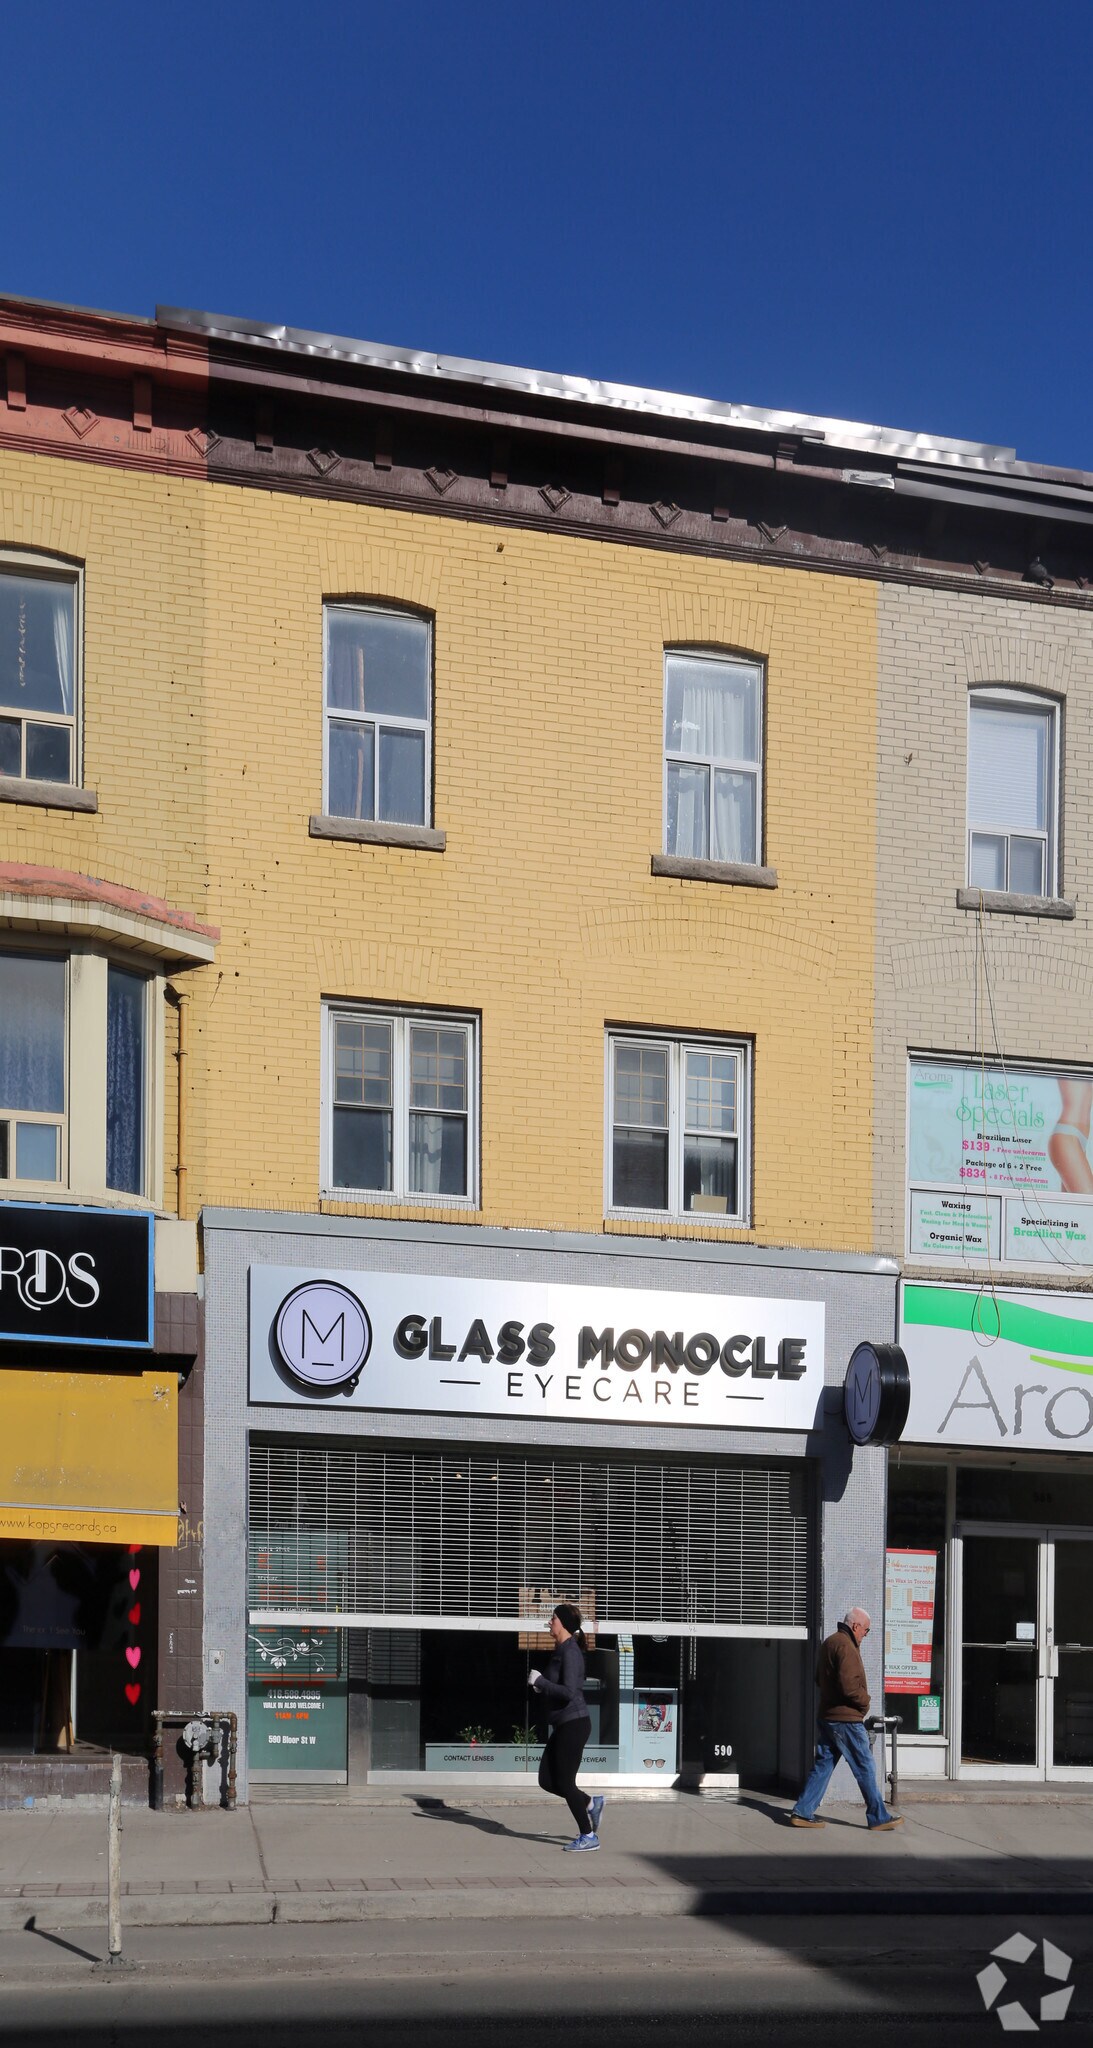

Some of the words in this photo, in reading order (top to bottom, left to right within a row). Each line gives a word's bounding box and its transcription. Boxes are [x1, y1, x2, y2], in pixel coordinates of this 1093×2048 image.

[915, 1069, 953, 1082] Aroma
[974, 1072, 1029, 1102] Laser
[956, 1097, 1045, 1131] Specials
[977, 1133, 1010, 1142] Brazilian
[1012, 1136, 1032, 1144] Laser
[962, 1140, 990, 1151] $139
[966, 1159, 996, 1169] Package
[959, 1167, 986, 1179] $834
[941, 1201, 971, 1211] Waxing
[1021, 1217, 1068, 1228] Specializing
[929, 1232, 963, 1242] Organic
[965, 1235, 982, 1243] Wax
[1013, 1226, 1062, 1239] Brazilian
[1065, 1230, 1086, 1240] Wax
[301, 1309, 345, 1361] M
[393, 1314, 556, 1367] GLASS
[577, 1325, 807, 1380] MONOCLE
[507, 1372, 699, 1406] EYECARE
[937, 1355, 1093, 1440] Aro
[268, 1735, 281, 1744] 590
[282, 1735, 300, 1744] Bloor
[301, 1736, 308, 1744] St
[309, 1736, 316, 1744] W
[714, 1745, 732, 1756] 590
